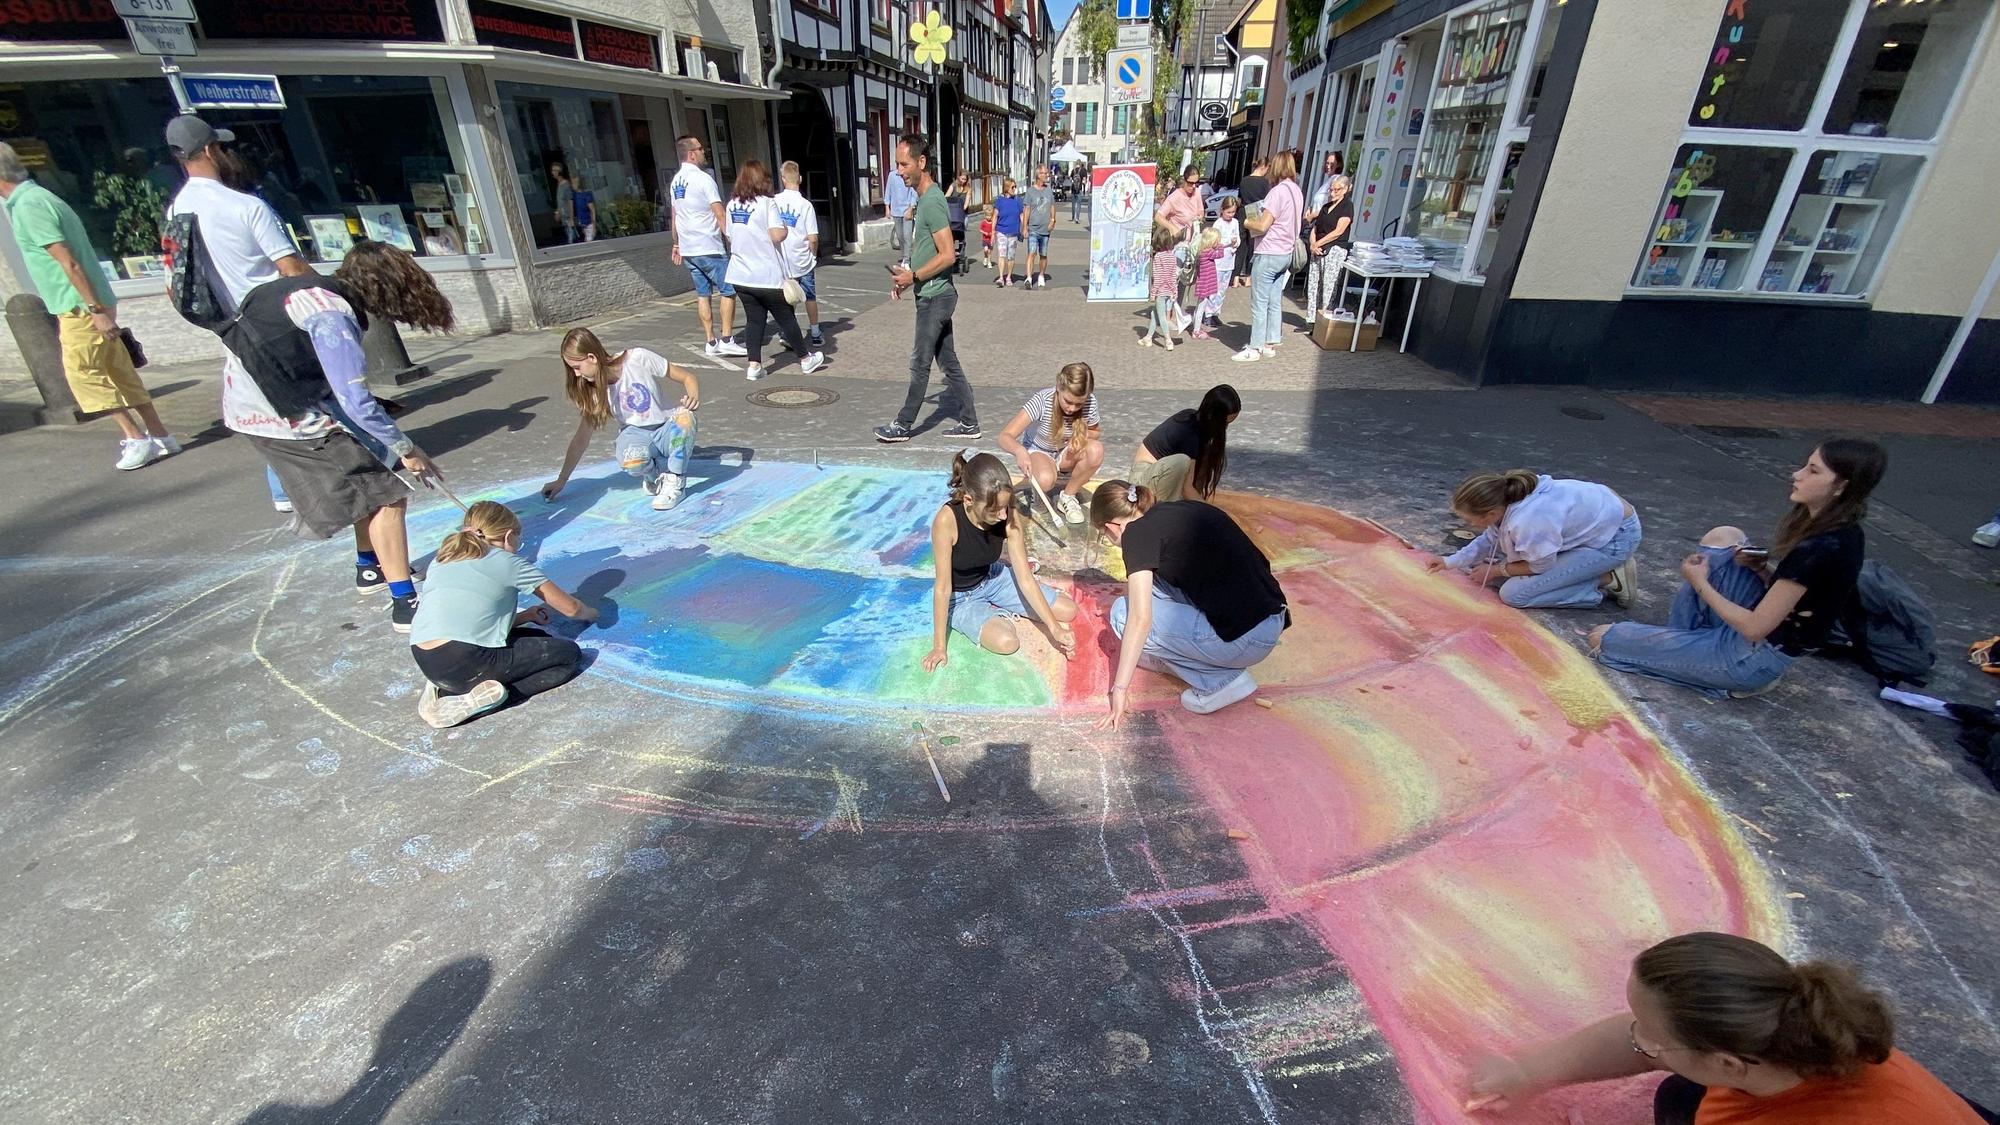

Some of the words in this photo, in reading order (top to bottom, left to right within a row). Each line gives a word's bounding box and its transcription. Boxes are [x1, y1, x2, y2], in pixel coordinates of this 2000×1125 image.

[135, 22, 185, 35] Anwohner
[263, 13, 416, 36] FOTOSERVICE
[157, 39, 176, 50] frei
[193, 82, 270, 100] Weiherstraße
